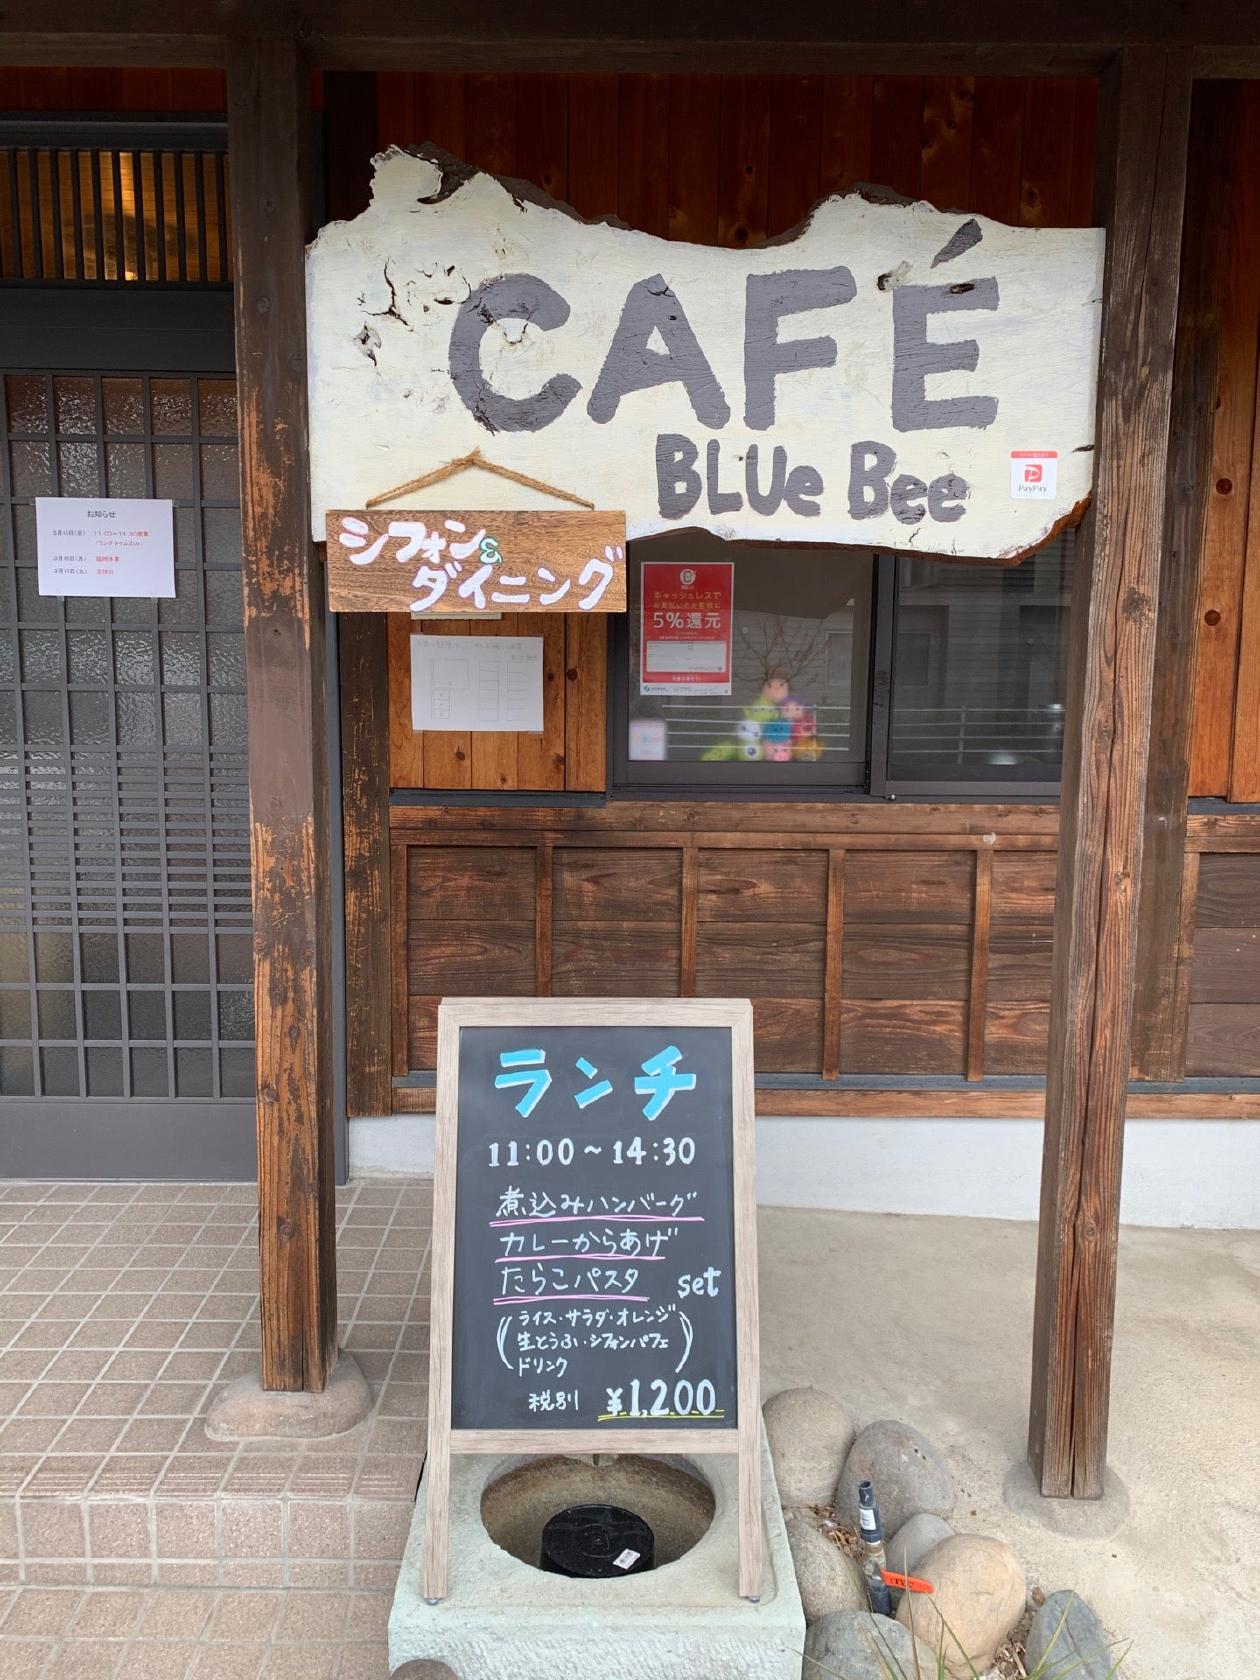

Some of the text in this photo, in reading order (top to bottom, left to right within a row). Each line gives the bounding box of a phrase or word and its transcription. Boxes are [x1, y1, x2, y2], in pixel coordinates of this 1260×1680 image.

[448, 218, 1000, 434] CAFÉ
[848, 440, 974, 525] Bee
[1018, 484, 1047, 494] PayPay
[87, 510, 117, 519] お知らせ
[409, 545, 624, 612] ダイニング
[653, 592, 721, 600] キャッシュレスで
[653, 612, 721, 629] 5%還元
[495, 1045, 697, 1121] ランチ
[495, 1185, 698, 1217] 煮込みハンバーグ
[499, 1227, 679, 1257] カレーからあげ
[501, 1263, 639, 1295] たらこパスタ
[677, 1266, 722, 1298] set
[518, 1357, 568, 1377] ドリンク
[528, 1389, 579, 1411] 税別
